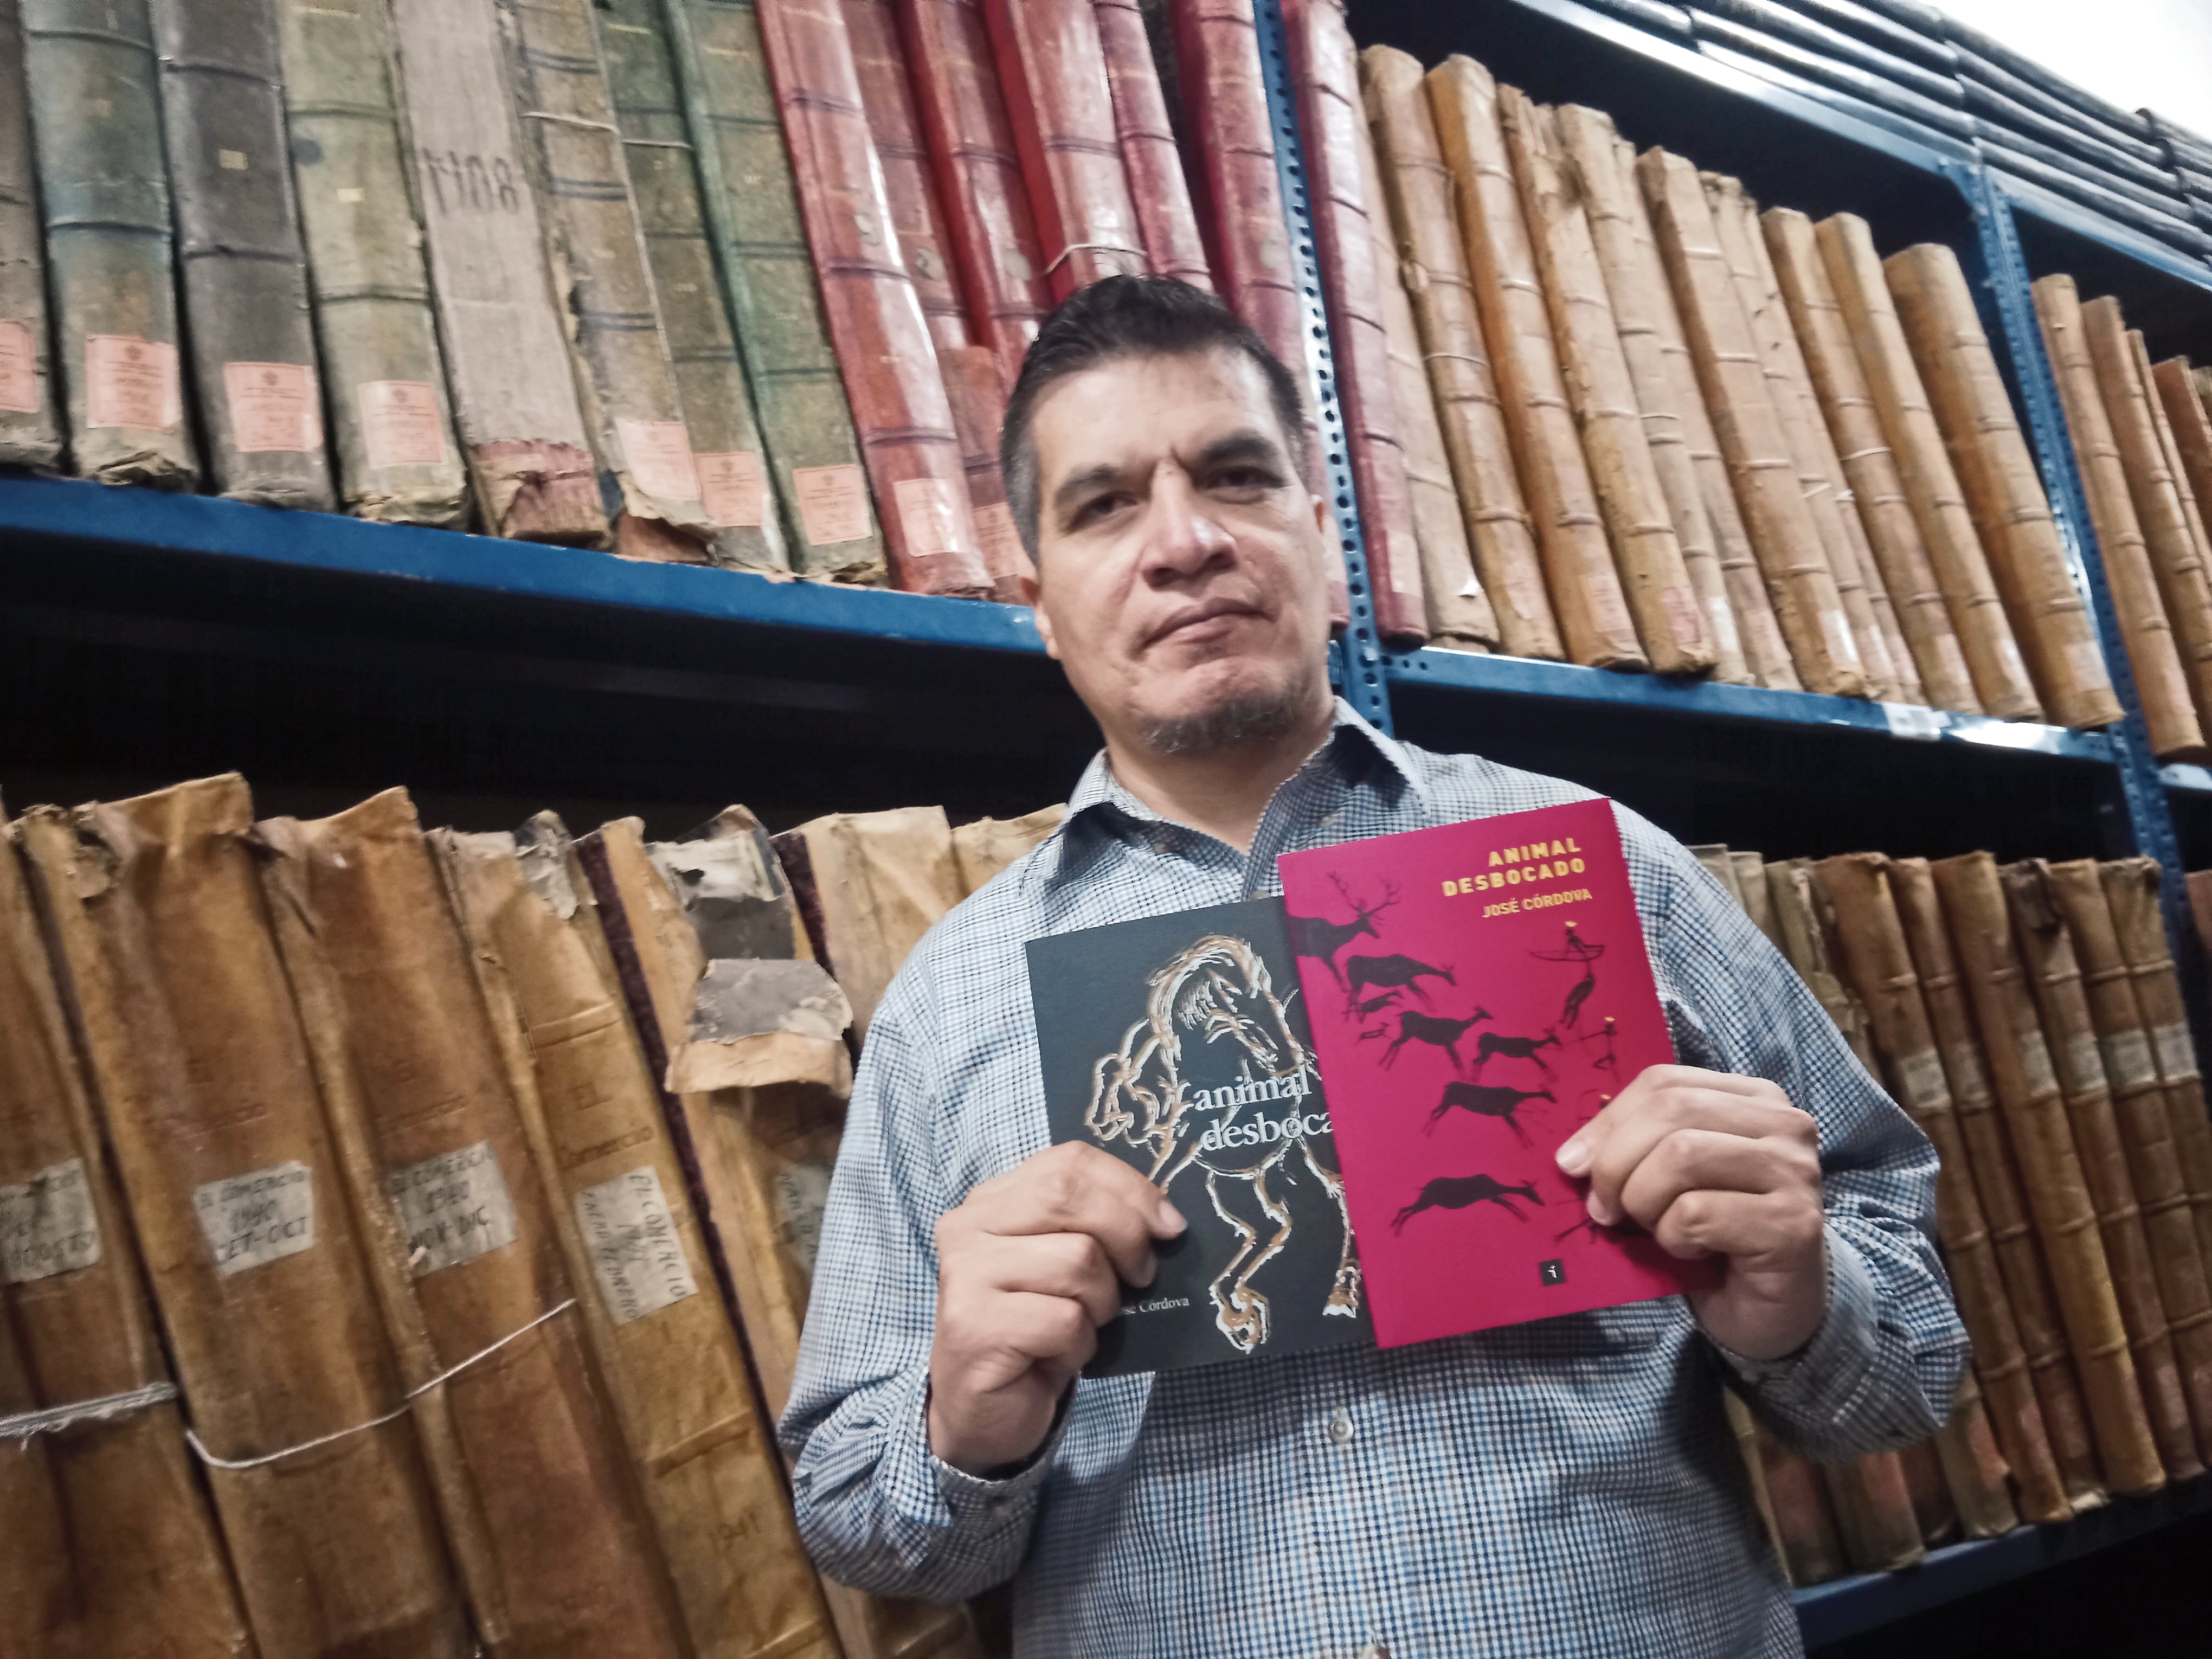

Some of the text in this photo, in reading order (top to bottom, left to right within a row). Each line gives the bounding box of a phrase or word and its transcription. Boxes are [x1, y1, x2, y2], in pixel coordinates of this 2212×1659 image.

[1488, 838, 1581, 866] ANIMAL
[1442, 858, 1585, 897] DESBOCADO
[1482, 888, 1593, 918] JOSÉ CÓRDOVA
[1192, 1065, 1312, 1111] animal
